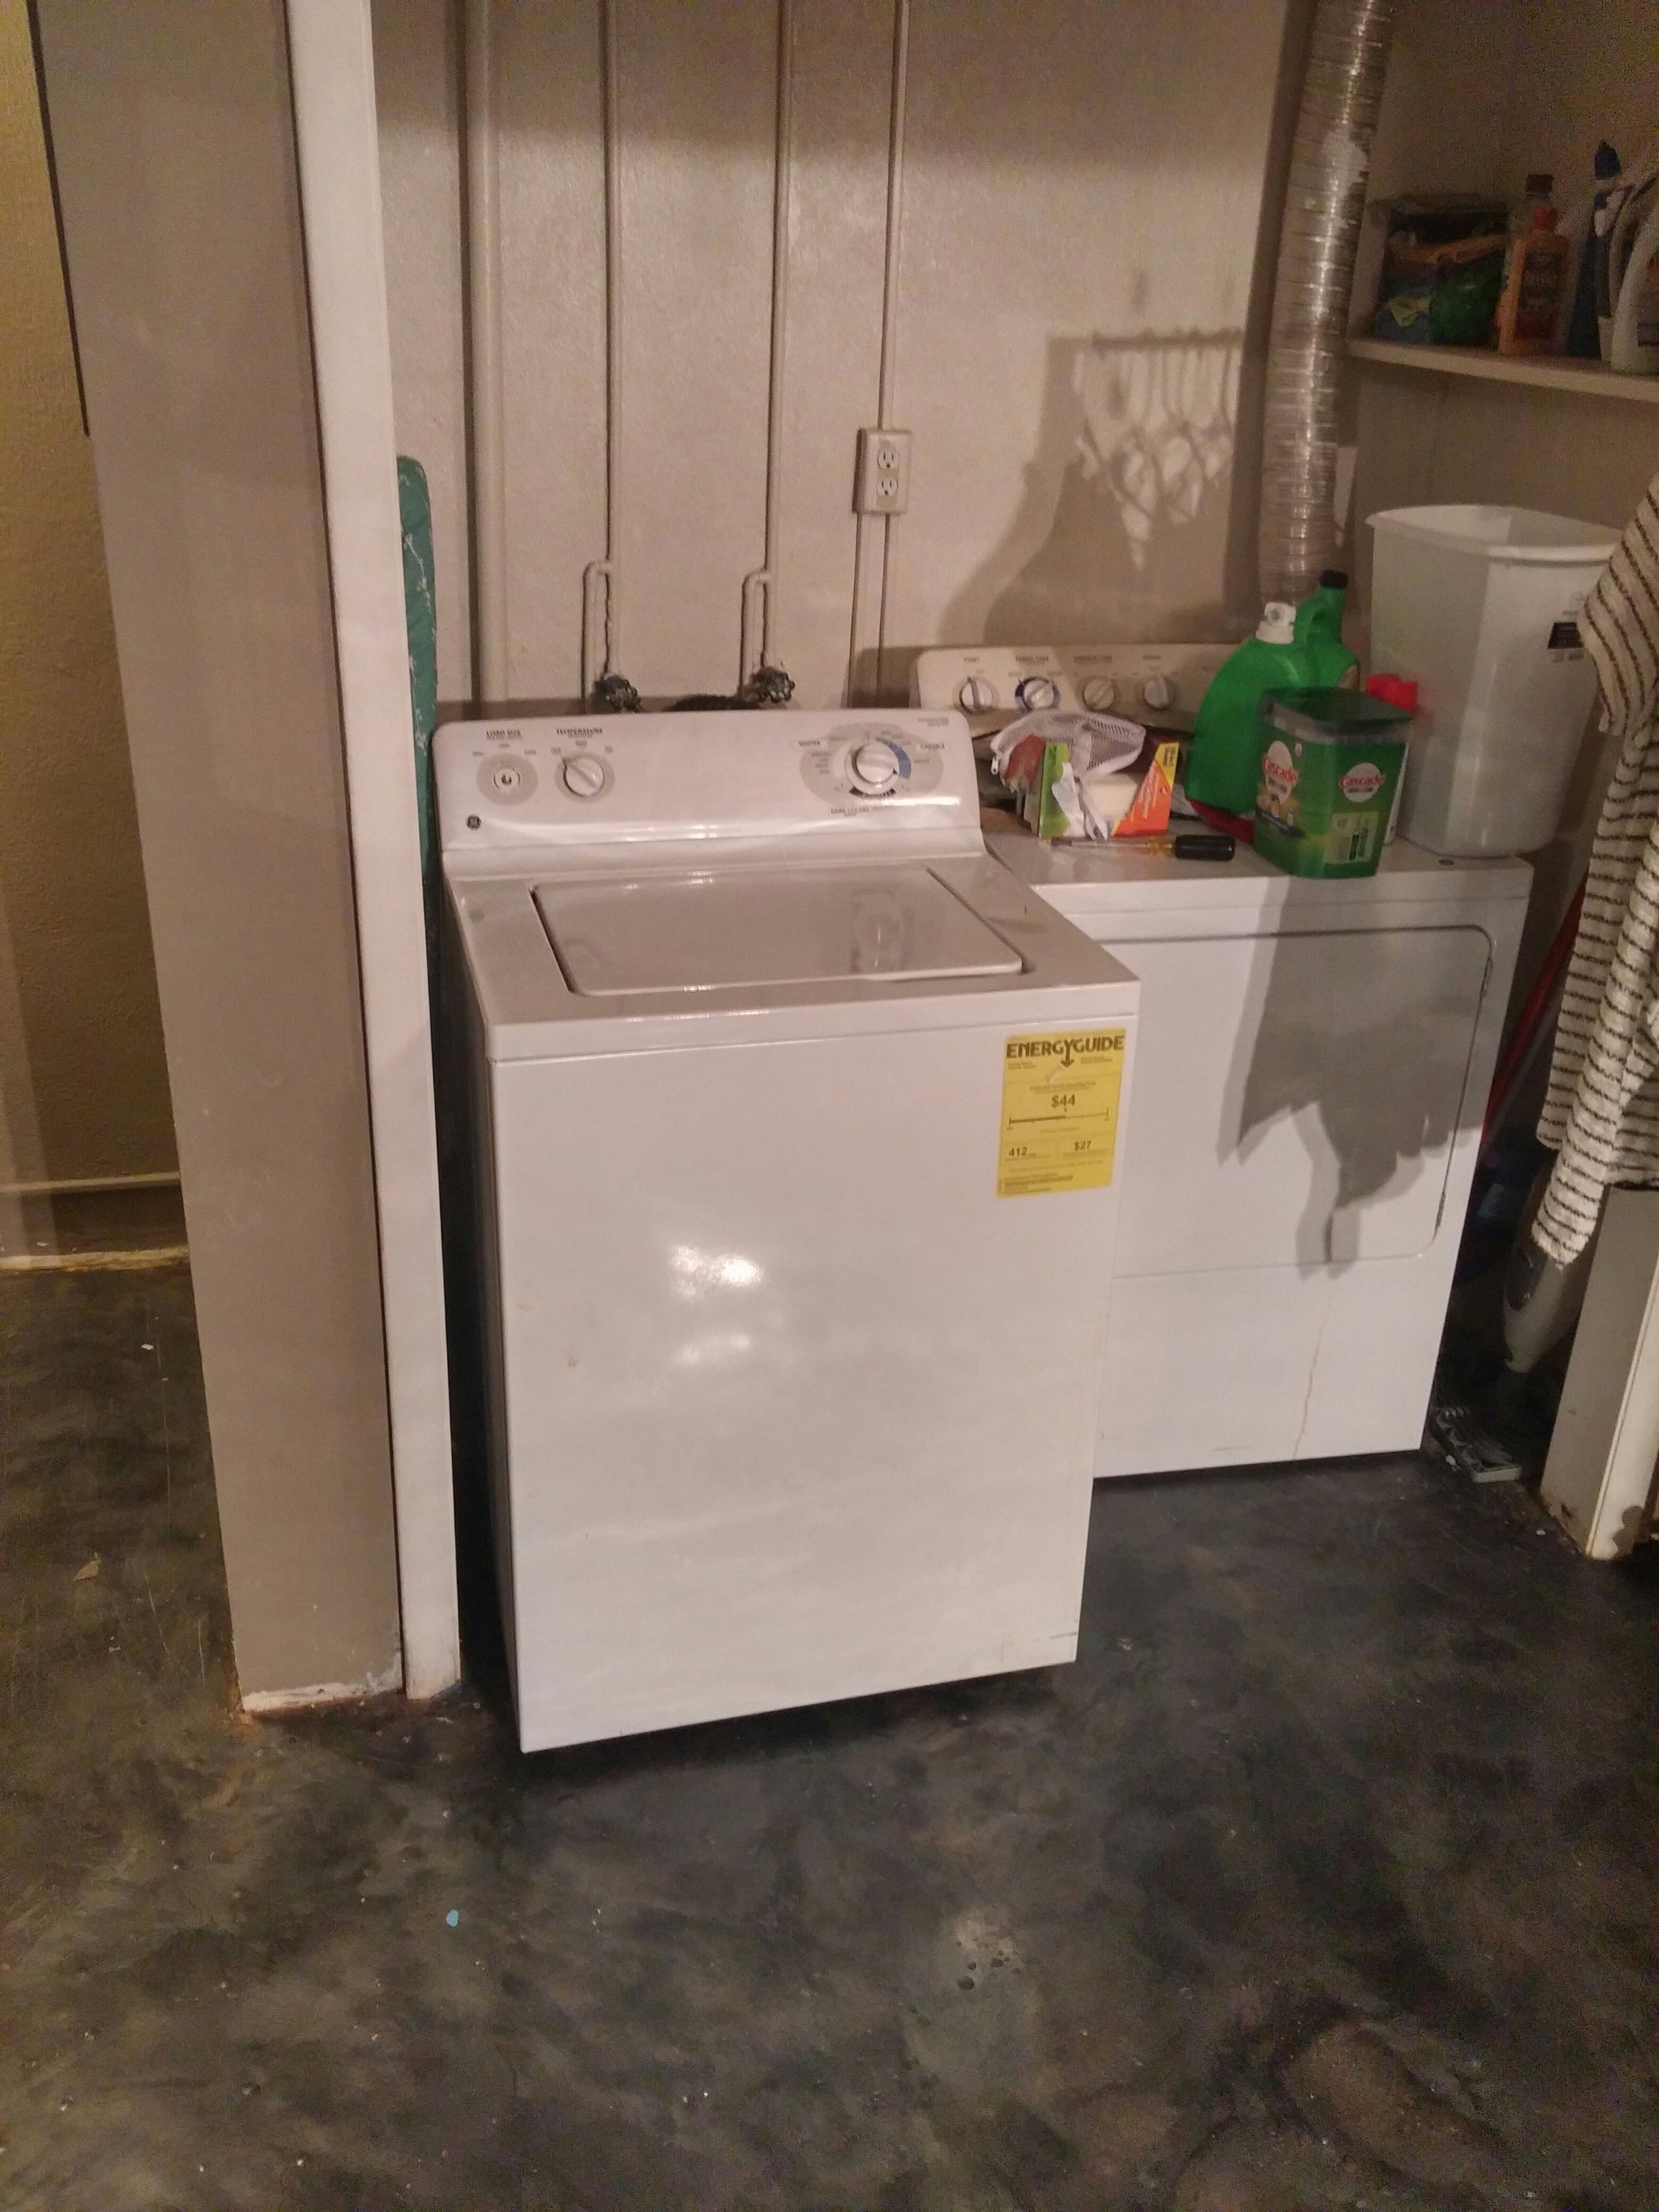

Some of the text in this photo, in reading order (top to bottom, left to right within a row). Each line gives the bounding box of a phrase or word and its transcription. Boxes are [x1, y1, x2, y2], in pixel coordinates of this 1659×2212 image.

[1340, 775, 1384, 788] Cascade
[1006, 1036, 1124, 1062] ENERGYGUIDE
[1051, 1094, 1076, 1108] $44
[1009, 1147, 1028, 1157] 412
[1074, 1140, 1091, 1151] $27
